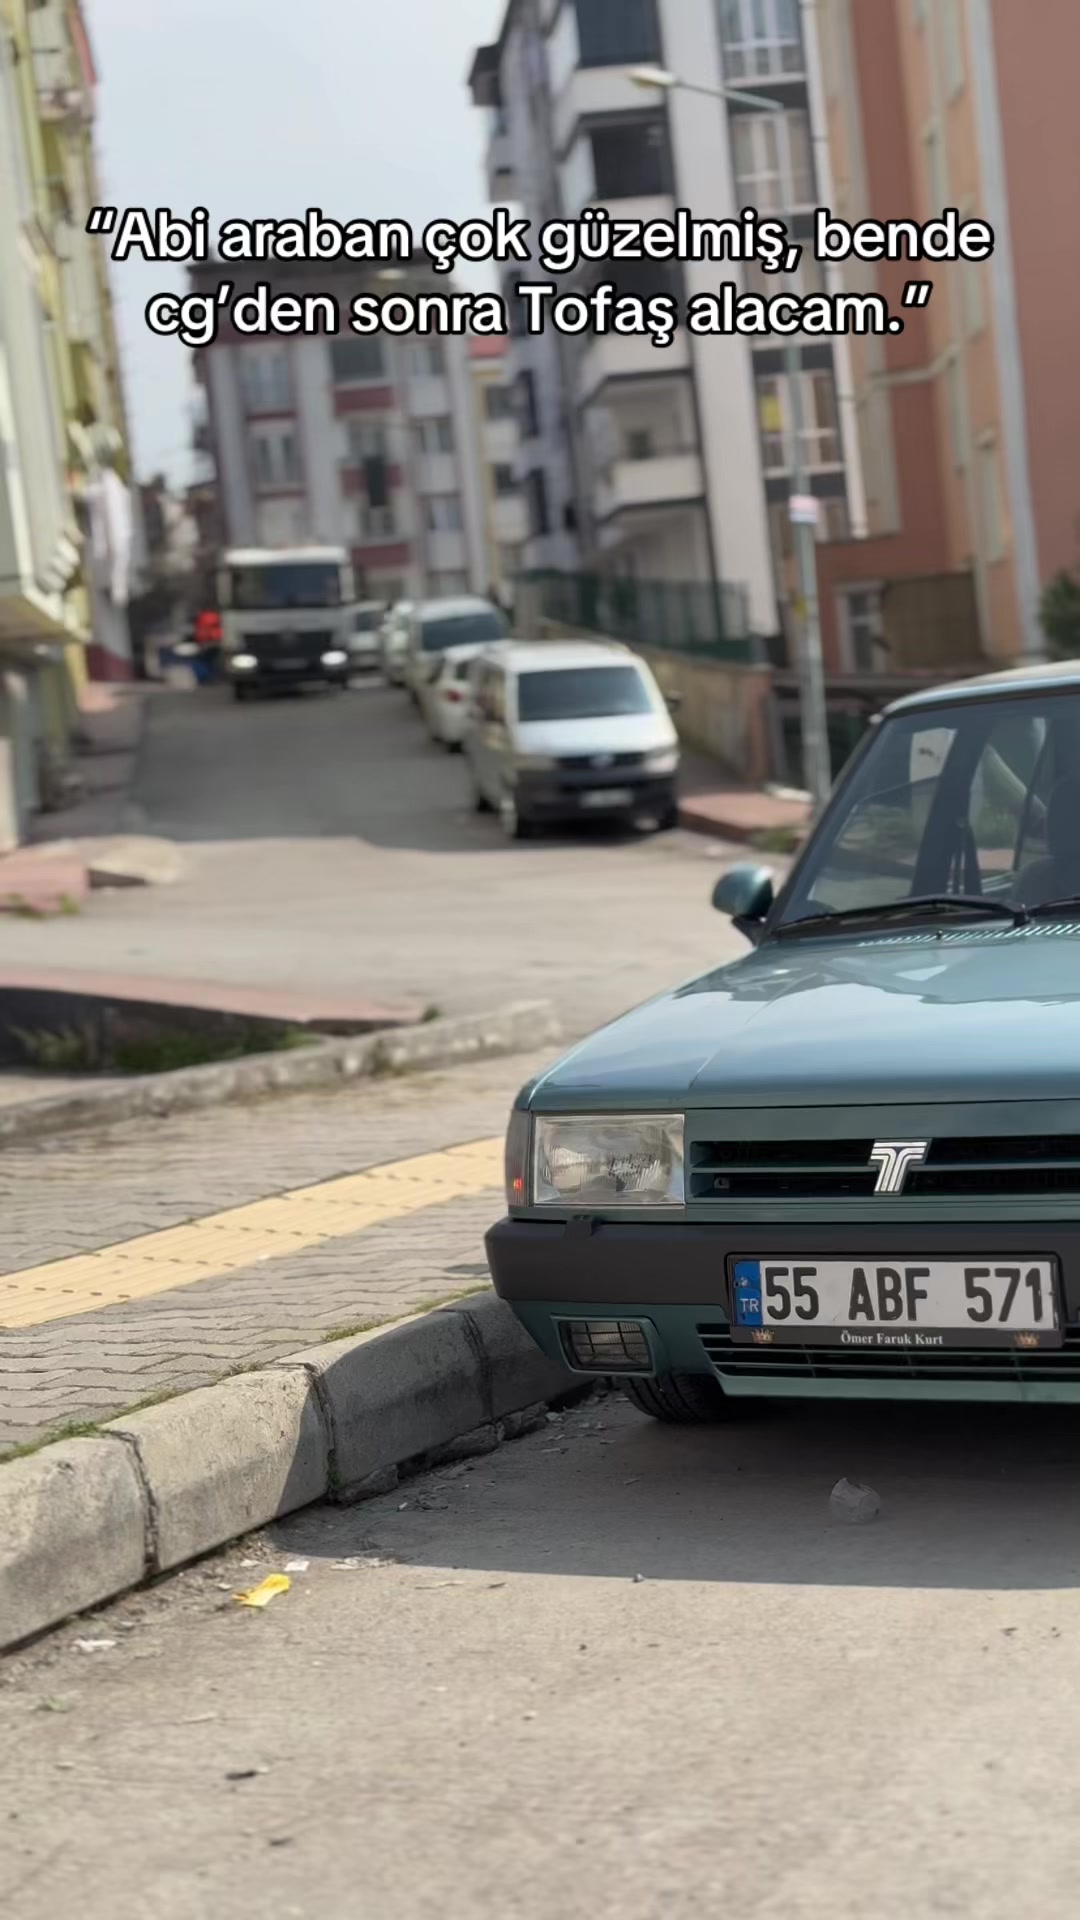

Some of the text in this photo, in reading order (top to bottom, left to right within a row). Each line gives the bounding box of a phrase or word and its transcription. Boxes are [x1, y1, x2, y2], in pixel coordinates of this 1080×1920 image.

[765, 1266, 1044, 1323] 55 ABF 571
[740, 1298, 760, 1313] TR
[840, 1329, 944, 1346] Ömer Faruk Kurt
